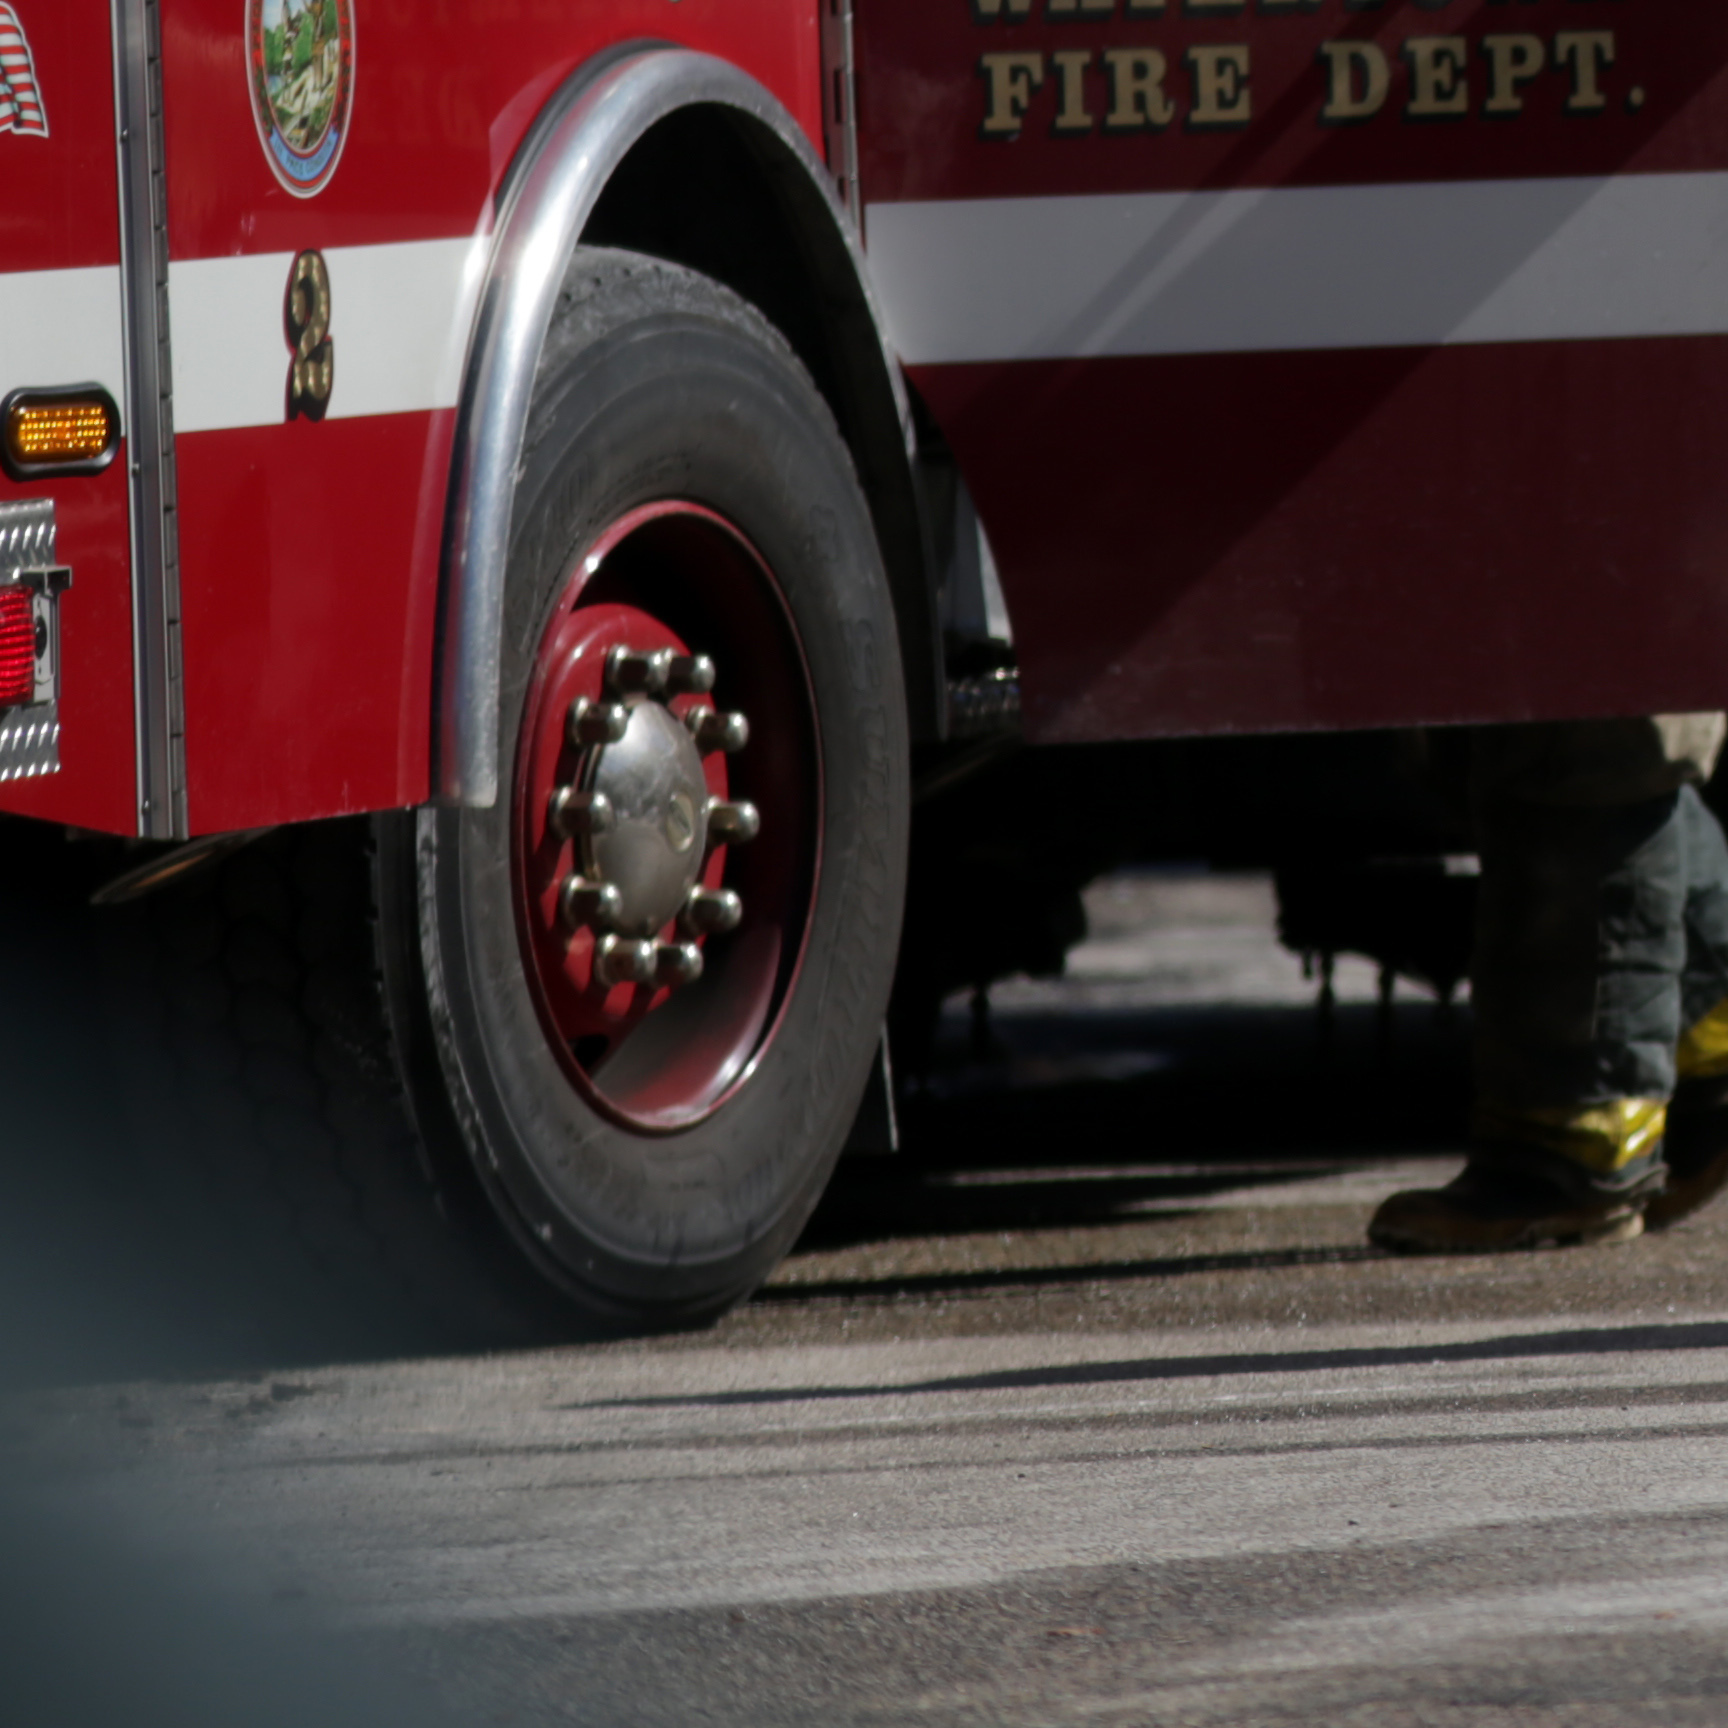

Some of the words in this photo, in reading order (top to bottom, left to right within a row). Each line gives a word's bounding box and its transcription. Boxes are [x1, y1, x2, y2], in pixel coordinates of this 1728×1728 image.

[978, 42, 1253, 136] FIRE
[1318, 30, 1647, 122] DEPT.
[288, 248, 334, 417] 2
